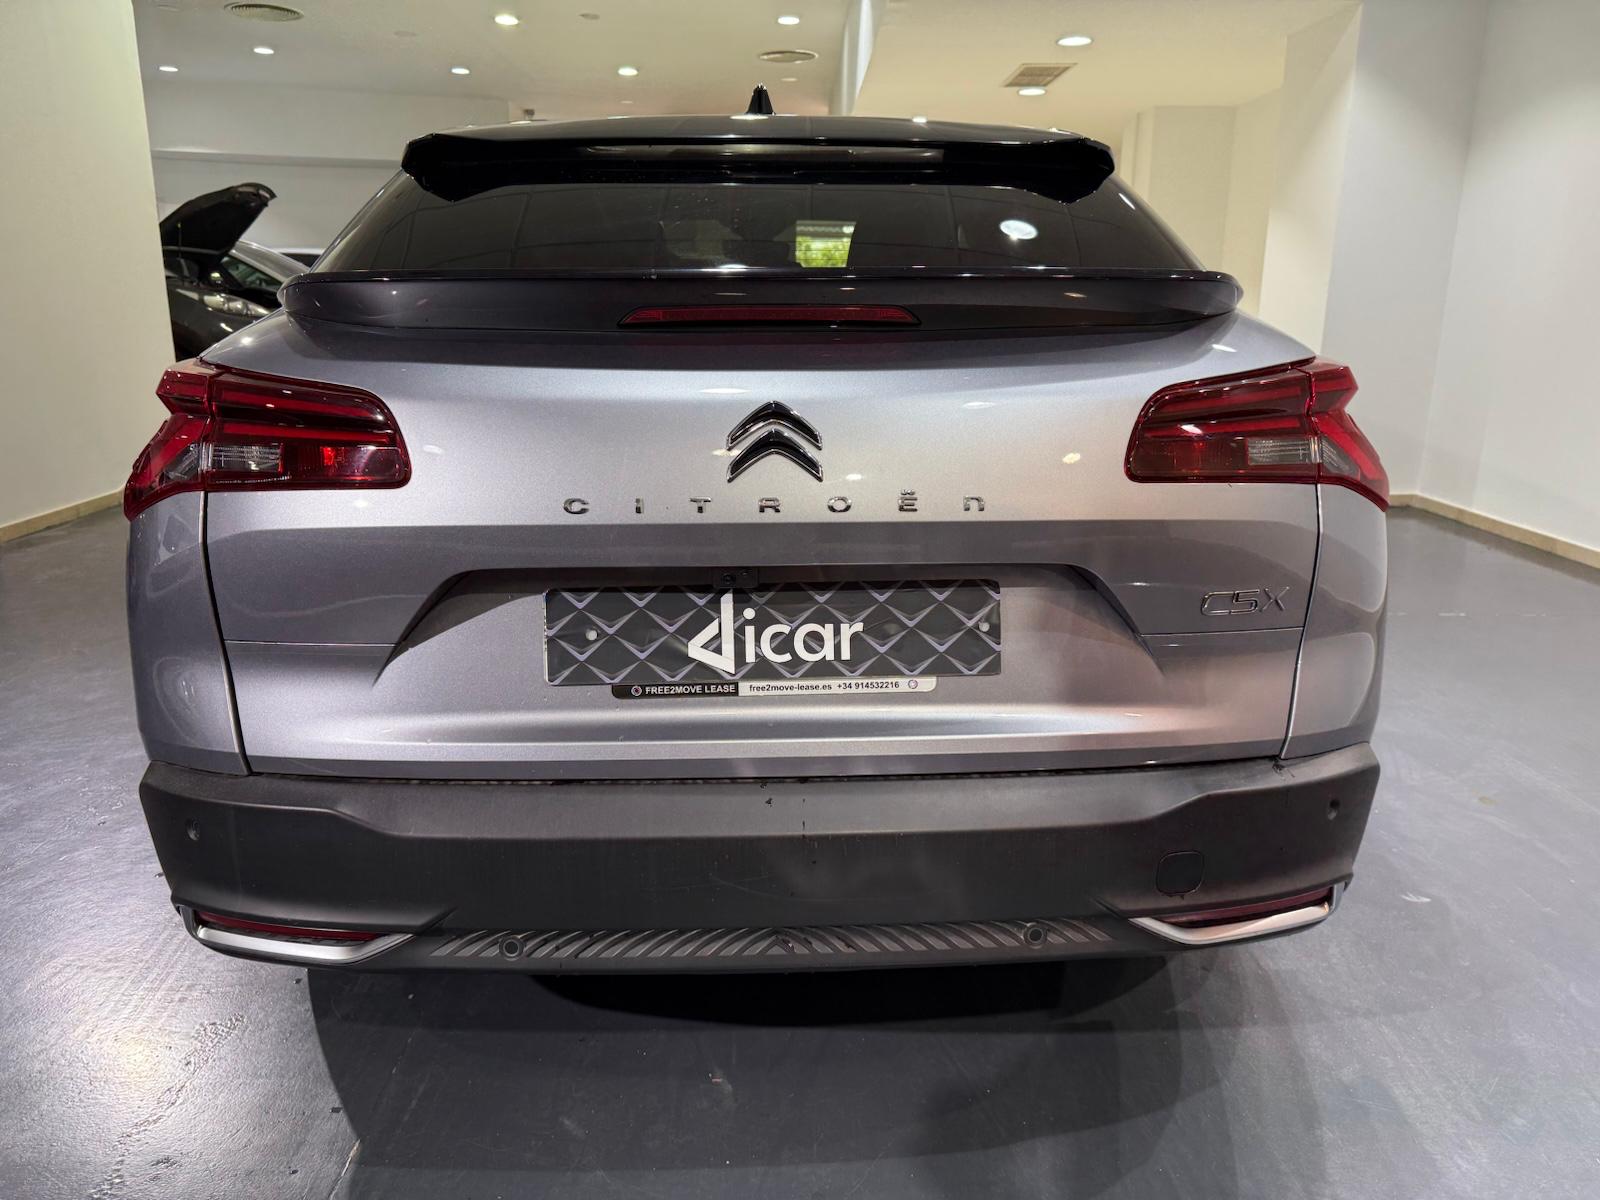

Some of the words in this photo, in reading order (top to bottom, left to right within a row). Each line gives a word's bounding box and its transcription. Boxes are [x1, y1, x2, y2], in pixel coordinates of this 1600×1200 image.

[645, 685, 702, 695] FREE2MOVE
[705, 684, 736, 694] LEASE
[749, 681, 832, 692] free2move-lease.es
[837, 682, 852, 691] +34
[855, 681, 900, 690] 914532216
